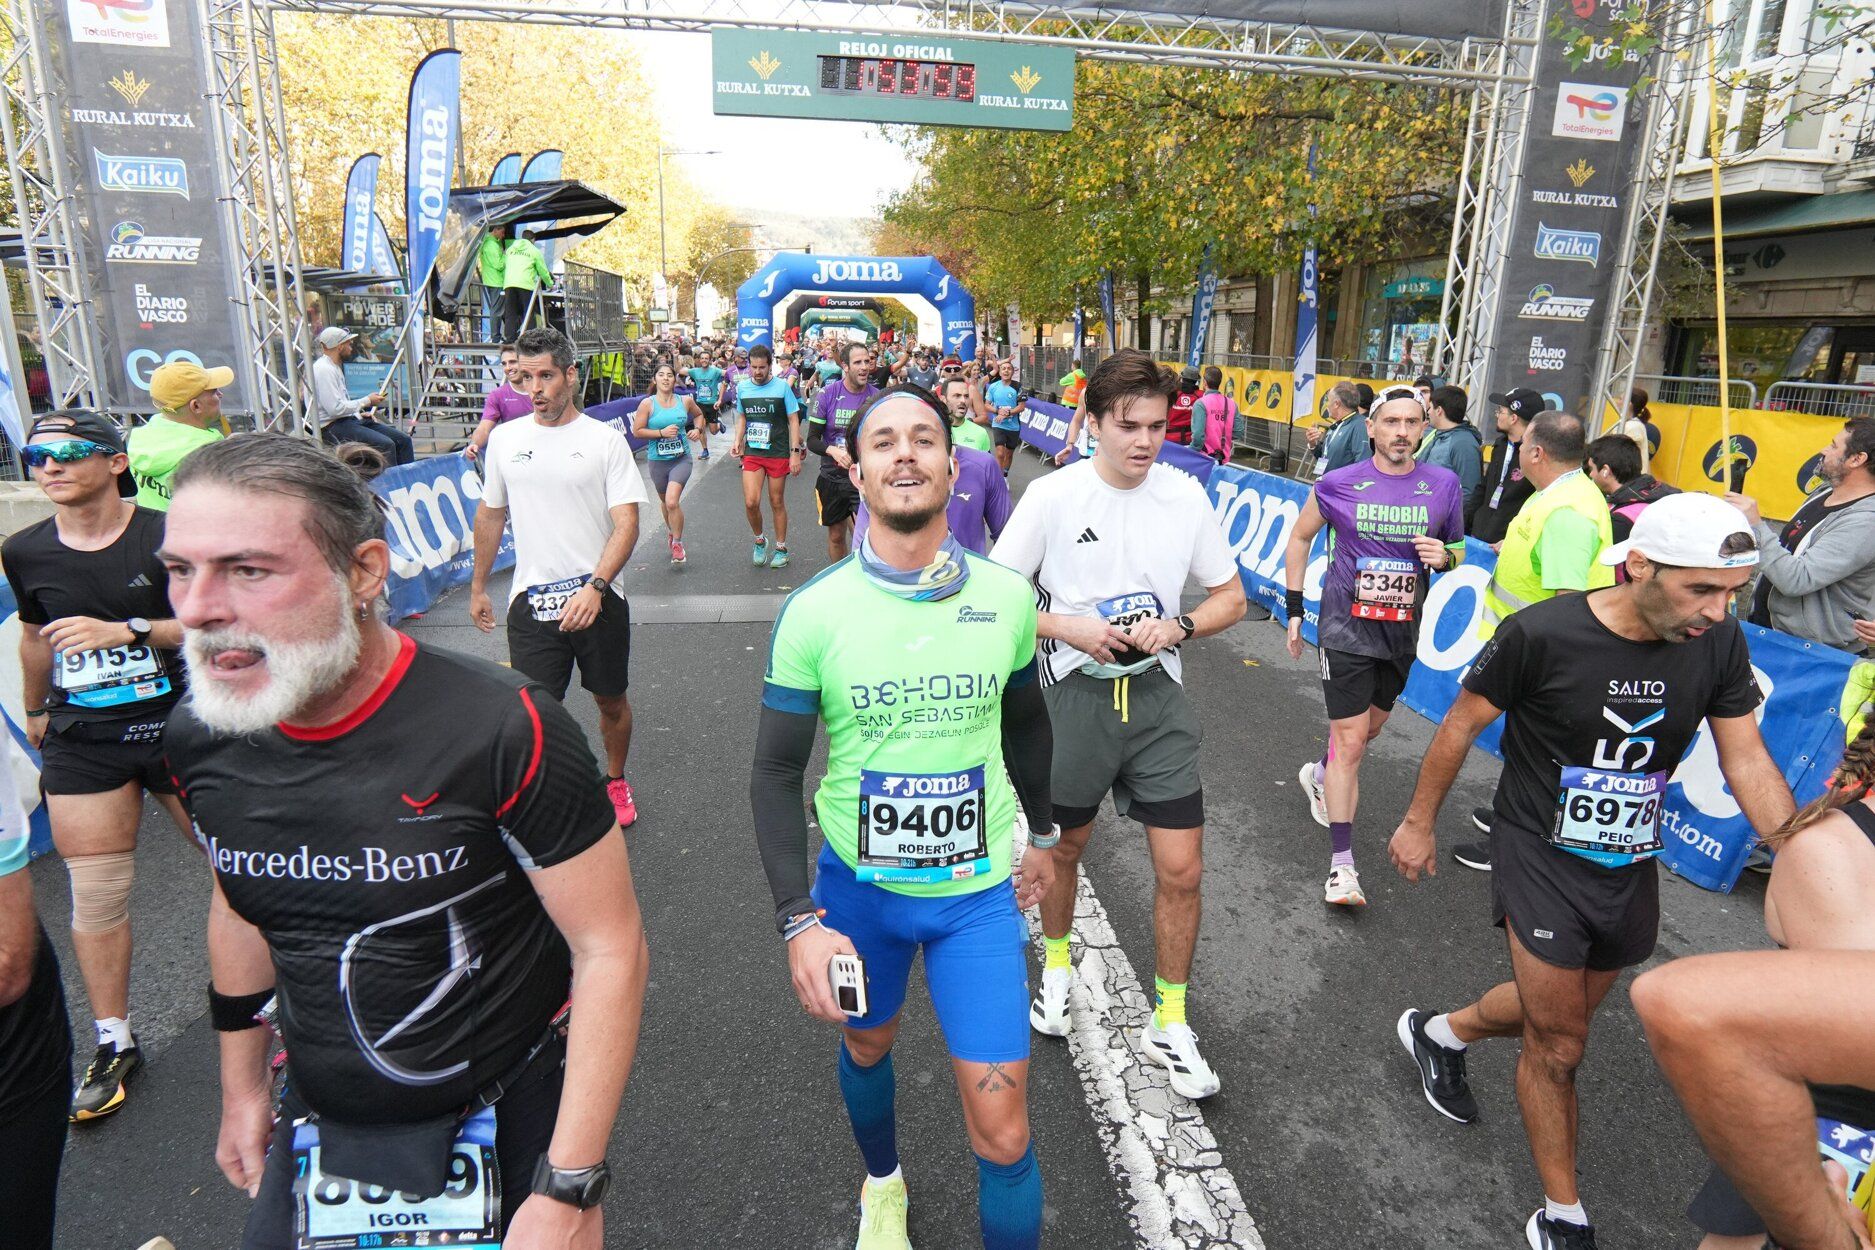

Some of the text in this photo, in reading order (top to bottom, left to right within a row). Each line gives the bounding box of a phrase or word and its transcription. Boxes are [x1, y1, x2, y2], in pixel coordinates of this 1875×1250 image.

[83, 26, 159, 41] TotalEnergies
[839, 42, 954, 61] RELOJ OFICIAL
[716, 81, 812, 97] RURAL KUTXA
[979, 95, 1069, 111] RURAL KUTXA
[73, 109, 196, 129] RURAL KUTXA
[1562, 123, 1614, 136] TotalEnergies
[106, 162, 179, 190] Kaiku
[418, 104, 449, 241] Joma
[1533, 190, 1618, 208] RURAL KUTXA
[352, 191, 371, 272] oma
[106, 244, 201, 260] RUNNING
[1540, 233, 1595, 258] Kaiku
[812, 259, 903, 284] Joma
[135, 284, 152, 296] EL
[136, 297, 188, 310] DIARIO
[343, 300, 396, 315] POWER
[1520, 302, 1590, 318] RUNNING
[139, 310, 188, 323] VASCO
[740, 317, 769, 328] Joma
[947, 320, 974, 329] Joma
[1531, 336, 1544, 347] EL
[1529, 348, 1567, 360] DIARIO
[1529, 359, 1565, 371] VASCO
[745, 405, 767, 413] salto
[1356, 503, 1429, 523] BEHOBIA
[1356, 521, 1376, 532] SAN
[1379, 560, 1414, 572] Joma
[548, 578, 582, 592] Joma
[1361, 573, 1416, 593] 3348
[1374, 594, 1403, 602] JAVIER
[851, 673, 999, 710] BEHOBIA
[1608, 680, 1666, 696] SALTO
[856, 713, 892, 727] SAN
[122, 730, 161, 741] RESS
[860, 729, 884, 739] 50/50
[888, 730, 911, 739] EGIN
[915, 728, 962, 739] DEZAGUN
[903, 773, 971, 797] Joma
[1601, 774, 1657, 794] Joma
[872, 798, 976, 838] 9406
[1568, 794, 1657, 829] 6978
[898, 841, 956, 855] ROBERTO
[369, 1212, 429, 1227] IGOR
